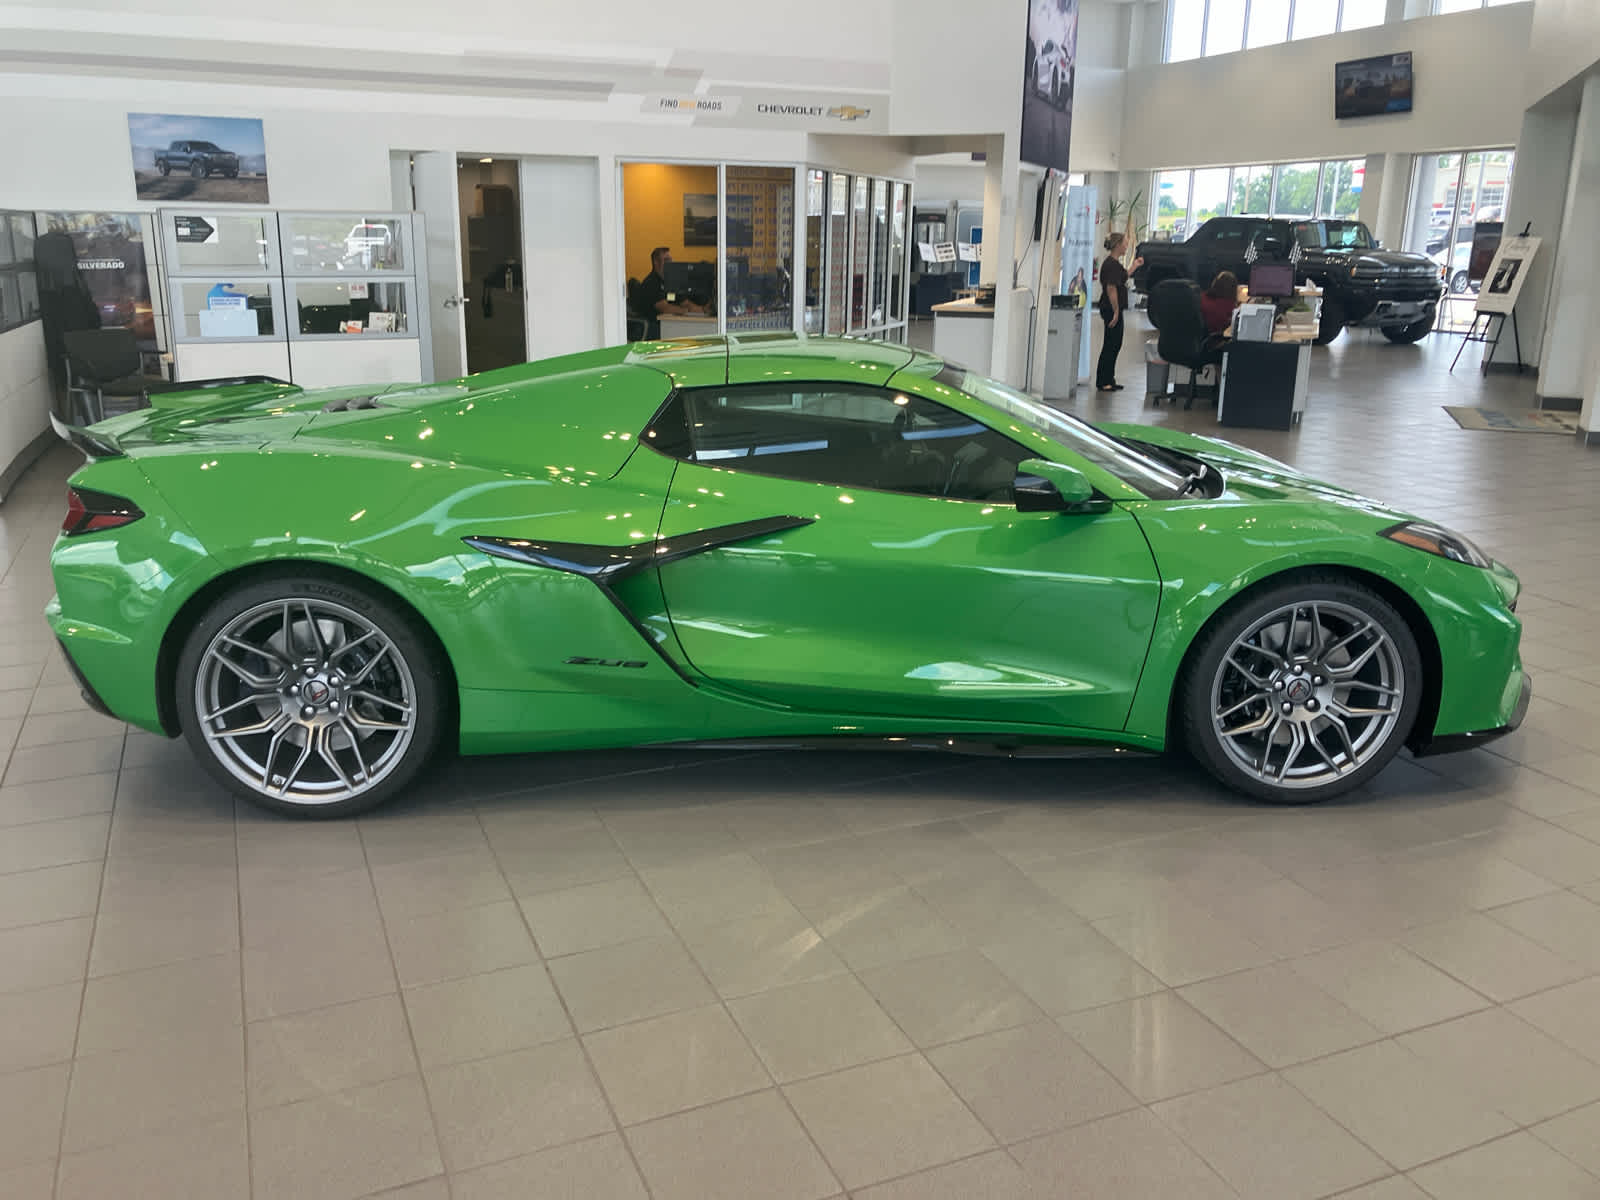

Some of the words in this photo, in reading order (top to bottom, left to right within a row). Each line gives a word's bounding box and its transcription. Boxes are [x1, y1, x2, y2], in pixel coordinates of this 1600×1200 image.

[659, 98, 679, 109] FIND
[696, 99, 723, 111] ROADS
[757, 103, 824, 116] CHEVROLET
[77, 262, 125, 270] SILVERADO
